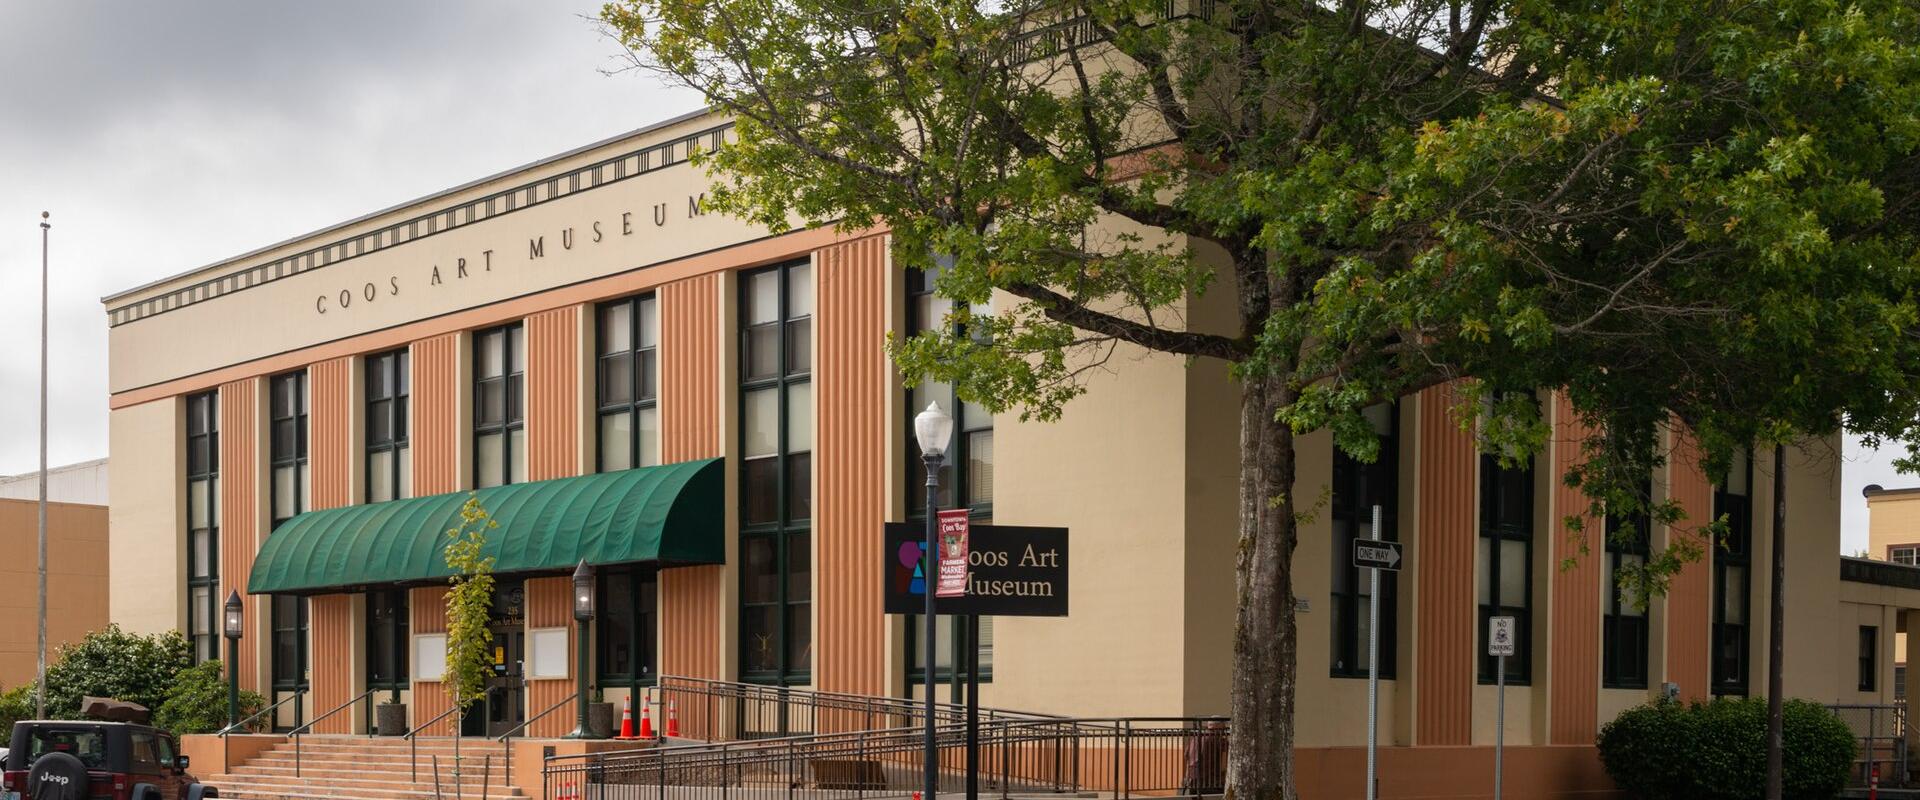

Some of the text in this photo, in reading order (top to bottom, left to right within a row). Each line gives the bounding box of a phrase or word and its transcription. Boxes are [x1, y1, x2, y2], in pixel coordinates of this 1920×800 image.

[316, 192, 706, 314] COOS ART MUSEUM
[968, 544, 1059, 568] oos Art
[1359, 547, 1389, 560] ONE WAY
[941, 566, 965, 574] MARKET
[41, 771, 69, 786] Jeep
